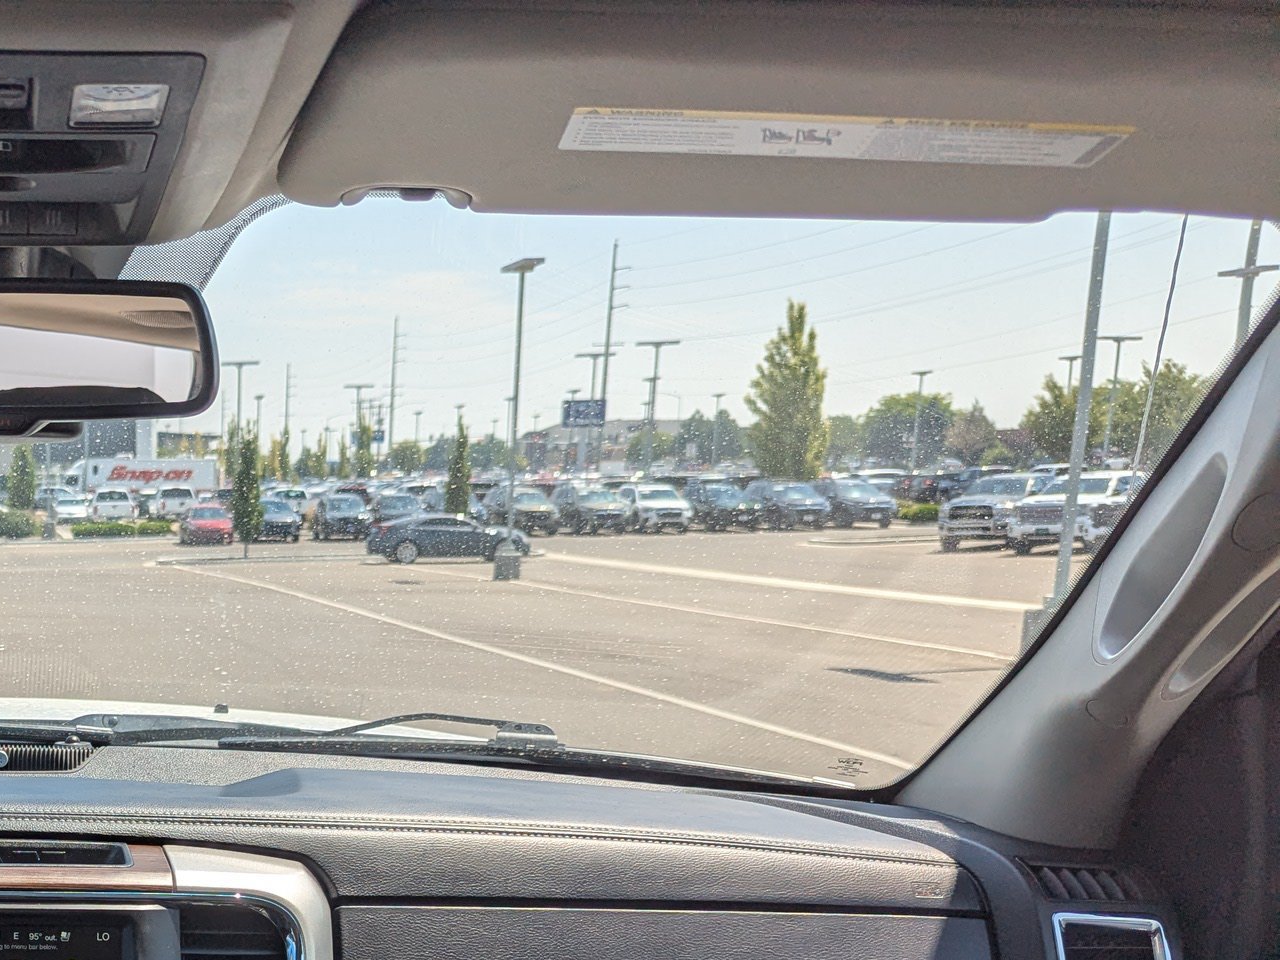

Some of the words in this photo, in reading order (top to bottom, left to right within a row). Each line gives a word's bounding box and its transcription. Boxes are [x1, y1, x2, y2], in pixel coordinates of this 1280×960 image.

[106, 464, 193, 485] Snap-on
[13, 931, 20, 940] E
[96, 932, 110, 942] LO
